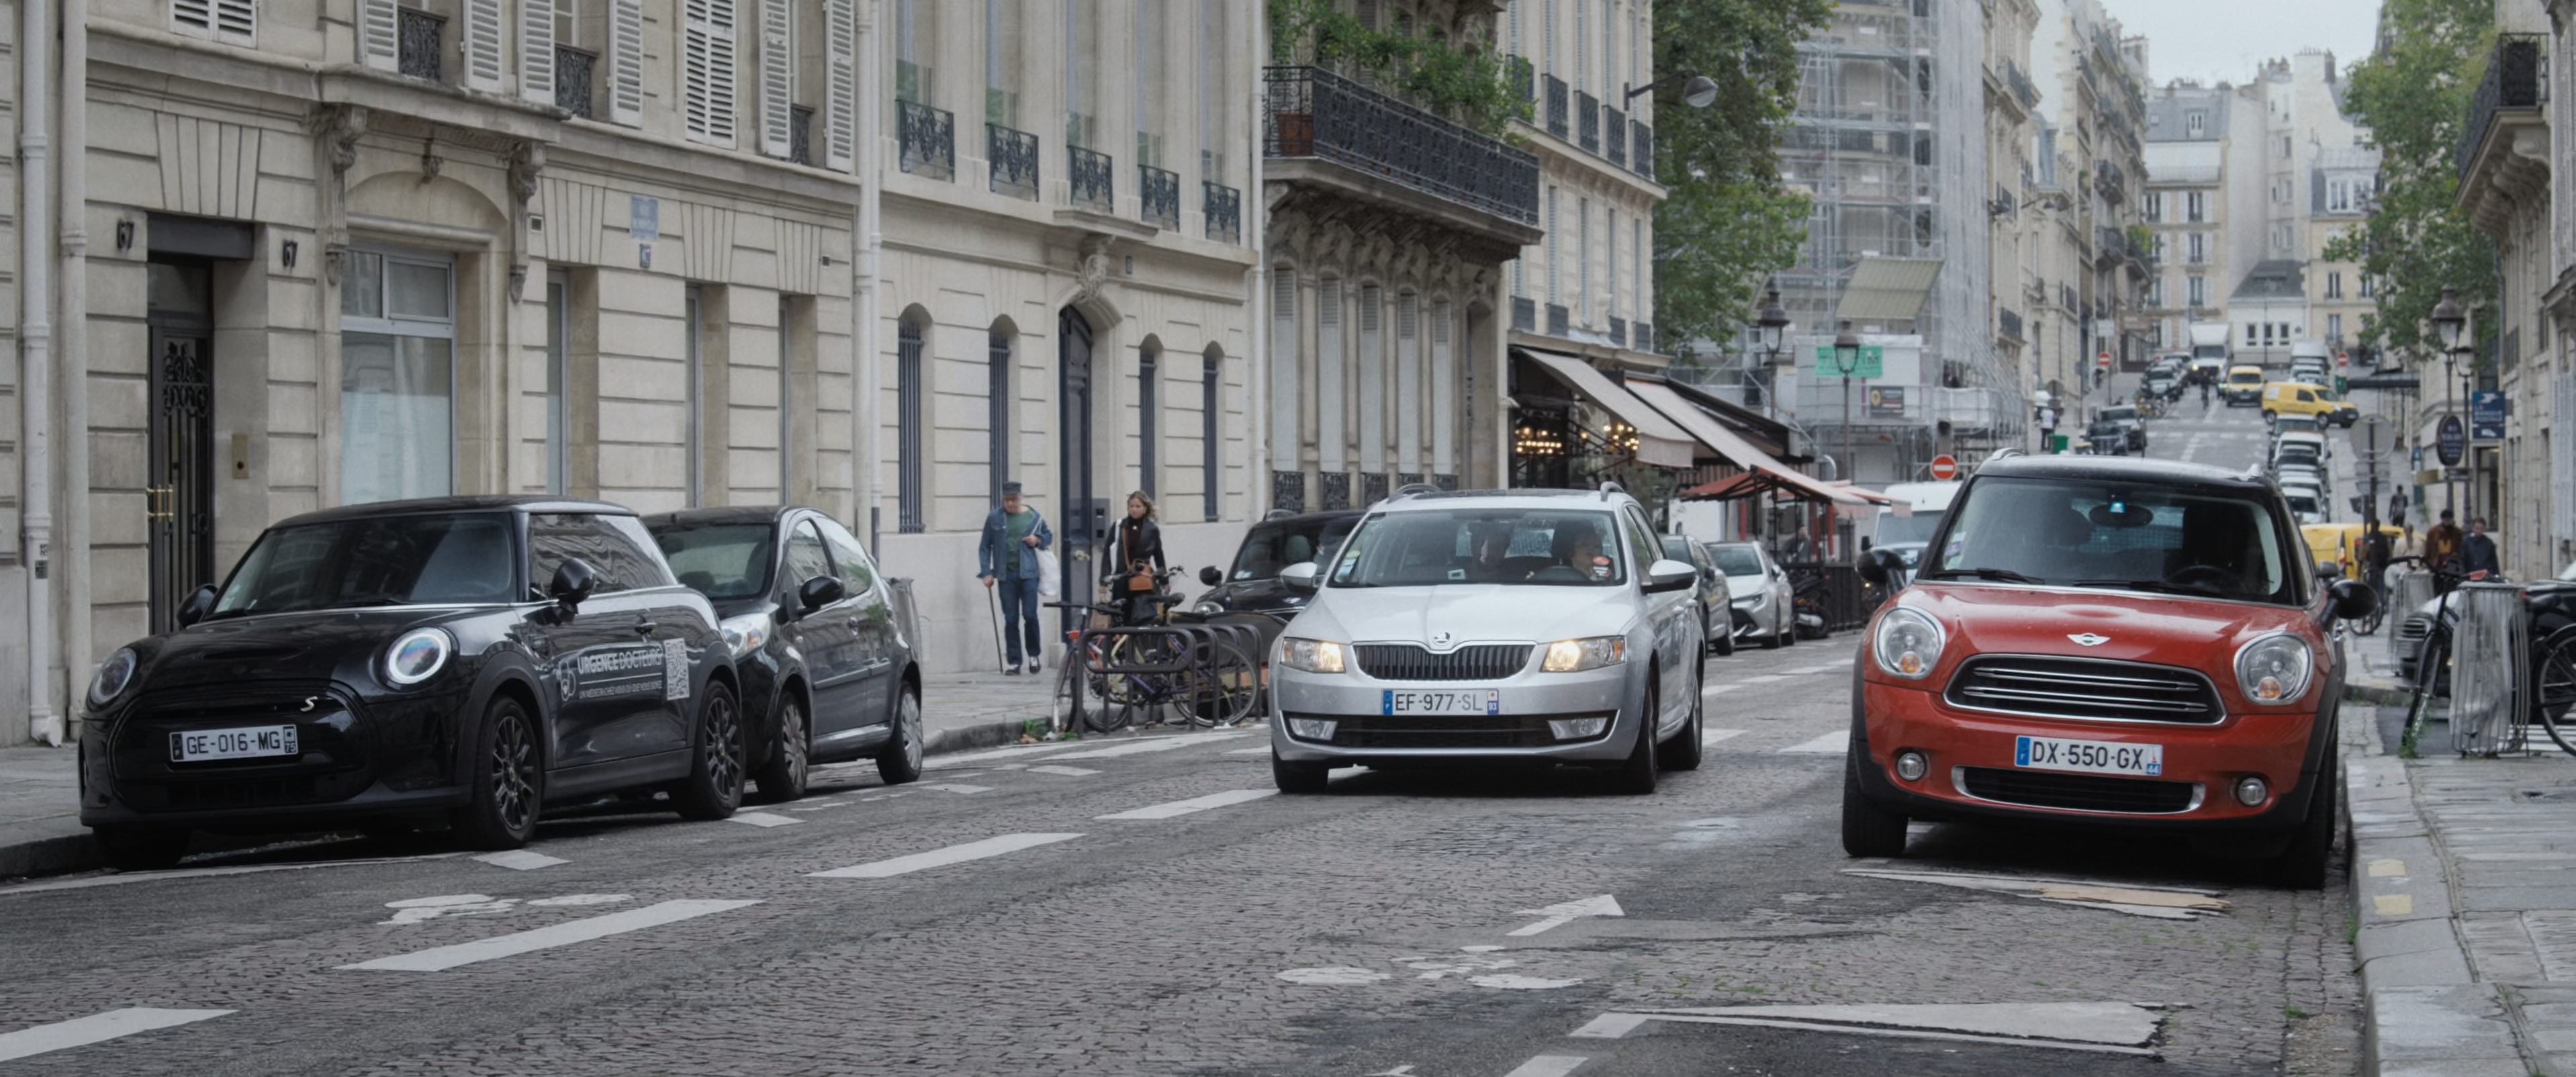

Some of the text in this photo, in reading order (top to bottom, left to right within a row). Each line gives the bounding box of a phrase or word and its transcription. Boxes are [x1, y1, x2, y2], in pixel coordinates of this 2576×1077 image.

[117, 220, 134, 249] 67
[283, 239, 297, 267] 67
[578, 649, 661, 674] URGENCE DOCTEURS
[300, 696, 318, 712] S
[1395, 694, 1483, 711] EF-977-SL
[187, 731, 280, 754] GE-016-MG
[285, 743, 296, 752] 75
[2032, 741, 2144, 769] DX-550-GX
